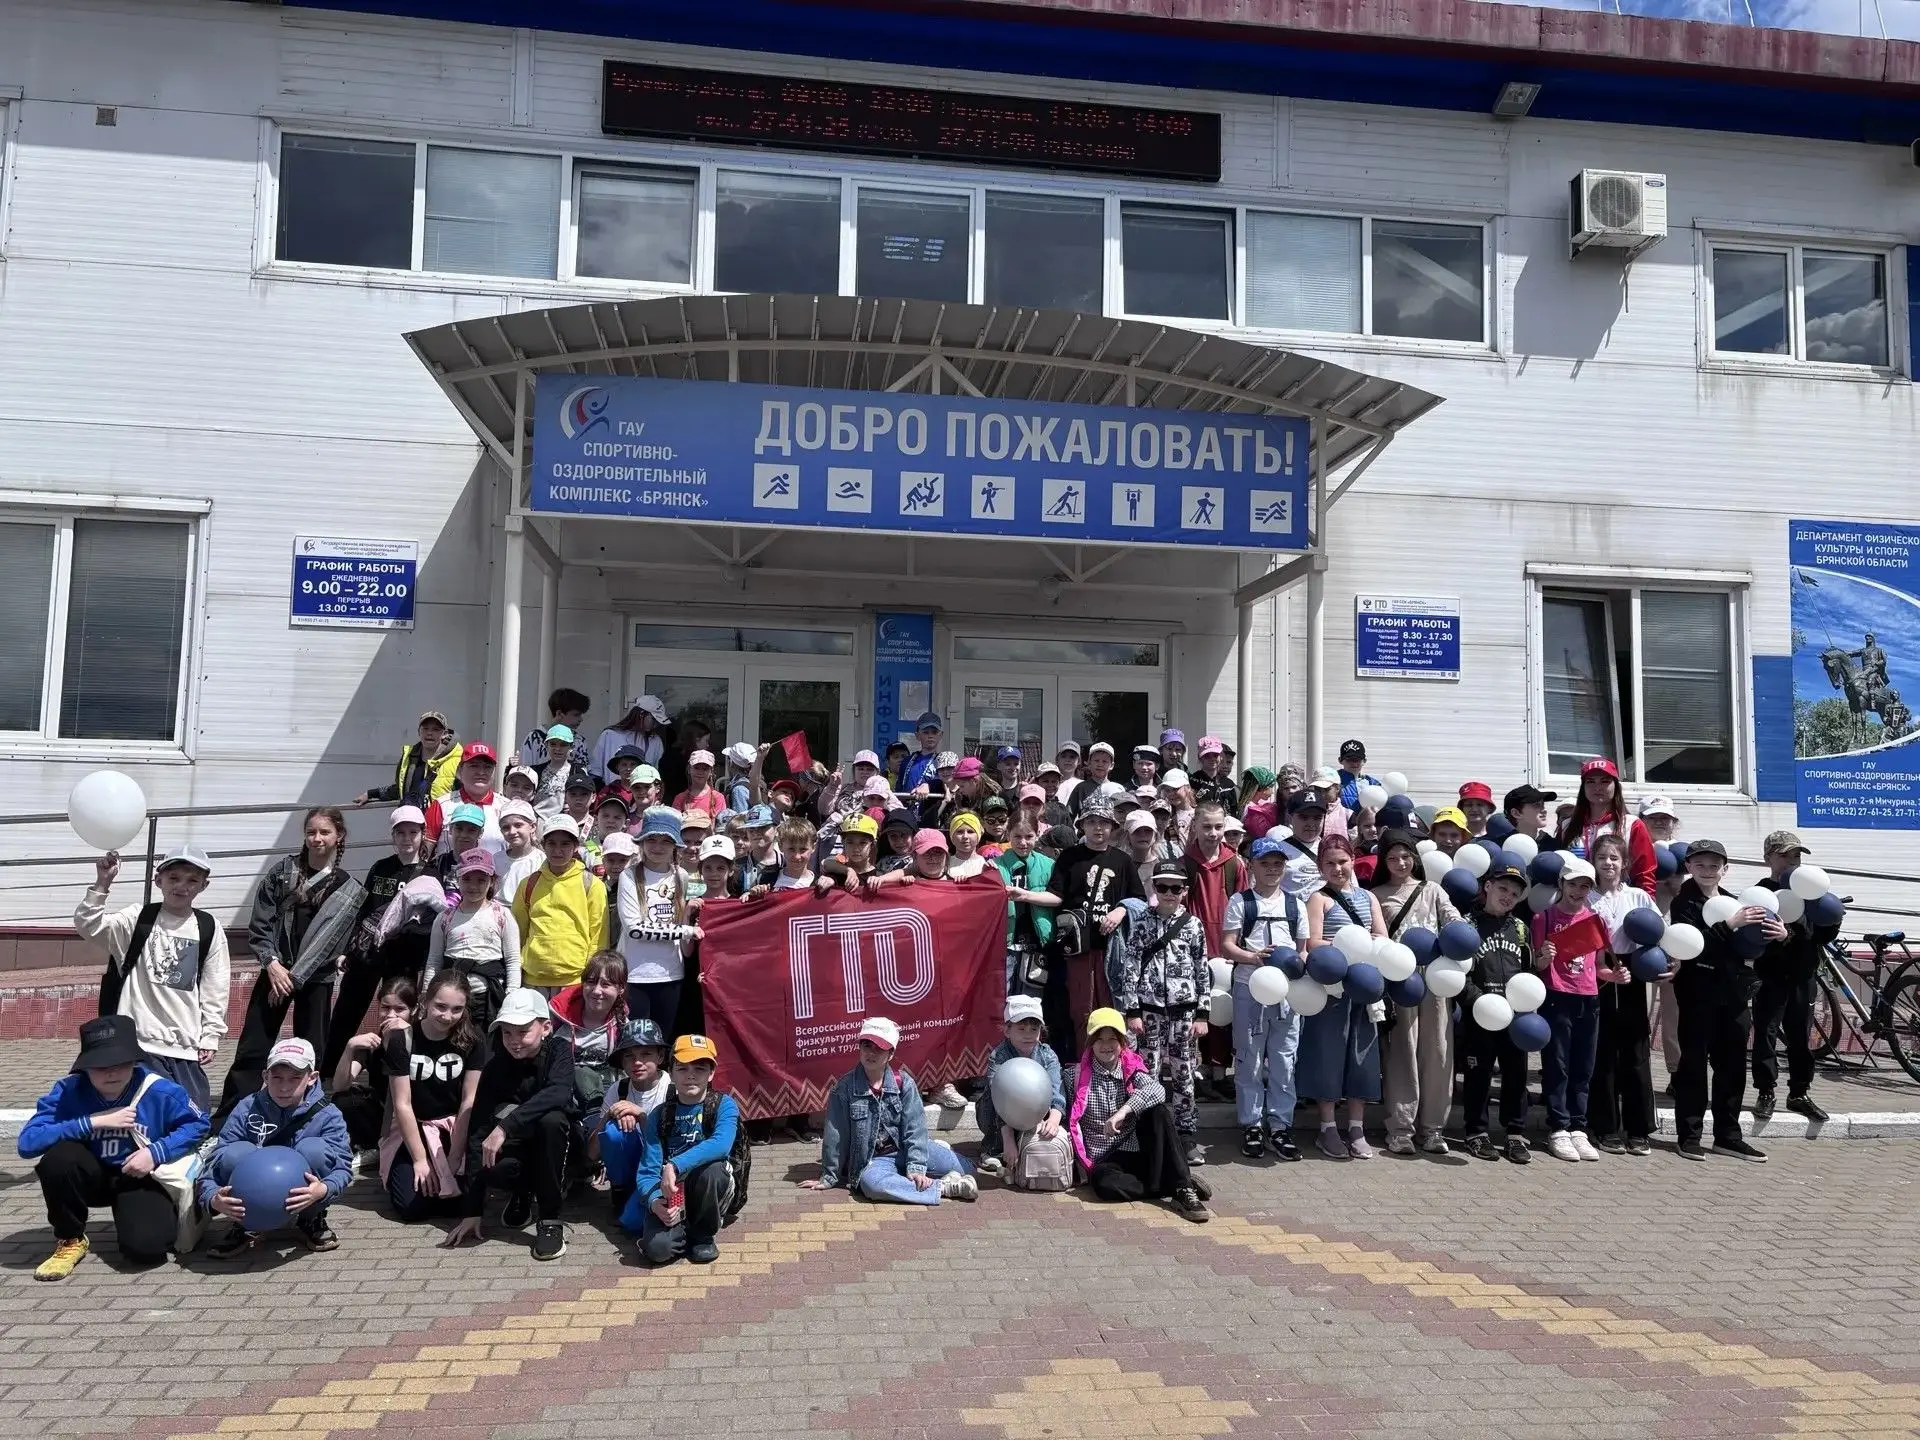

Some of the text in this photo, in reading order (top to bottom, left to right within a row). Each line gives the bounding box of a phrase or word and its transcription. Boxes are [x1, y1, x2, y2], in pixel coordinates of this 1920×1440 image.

[618, 421, 645, 437] ГАУ
[754, 400, 1294, 476] ДОБРО ПОЖАЛОВАТЬ!
[583, 442, 678, 461] СПОРТИВНО-
[553, 463, 707, 485] ОЗДОРОВИТЕЛЬНЫЙ
[549, 486, 709, 508] КОМПЛЕКС «БРЯНСК»
[1796, 531, 1920, 545] ДЕПАРТАМЕНТ ФИЗИЧЕСКО
[1815, 544, 1909, 556] КУЛЬТУРЫ И СПОРТА
[306, 560, 405, 574] ГРАФИК РАБОТЫ
[1816, 555, 1909, 568] БРЯНСКОЙ ОБЛАСТИ
[331, 574, 379, 583] ЕЖЕДНЕВНО
[302, 580, 340, 595] 9.00
[357, 583, 407, 597] 22.00
[318, 604, 347, 612] 13.00
[360, 606, 389, 614] 14.00
[1368, 618, 1451, 629] ГРАФИК РАБОТЫ
[1429, 633, 1453, 641] 17.30
[876, 674, 893, 749] ИНФОР
[472, 744, 490, 754] ГТО
[1588, 760, 1606, 770] ГТО
[1805, 770, 1920, 781] СПОРТИВНО-ОЗДОРОВИТЕЛЬН
[1829, 782, 1911, 791] КОМПЛЕКС «БРЯНСК»
[1860, 797, 1874, 805] 2-я
[1832, 807, 1857, 816] (4832)
[788, 907, 935, 1020] ГТО
[923, 1013, 965, 1030] комплекс
[796, 1046, 829, 1059] «Готов
[830, 1046, 837, 1054] к
[838, 1042, 860, 1056] труд
[101, 1139, 120, 1159] 10
